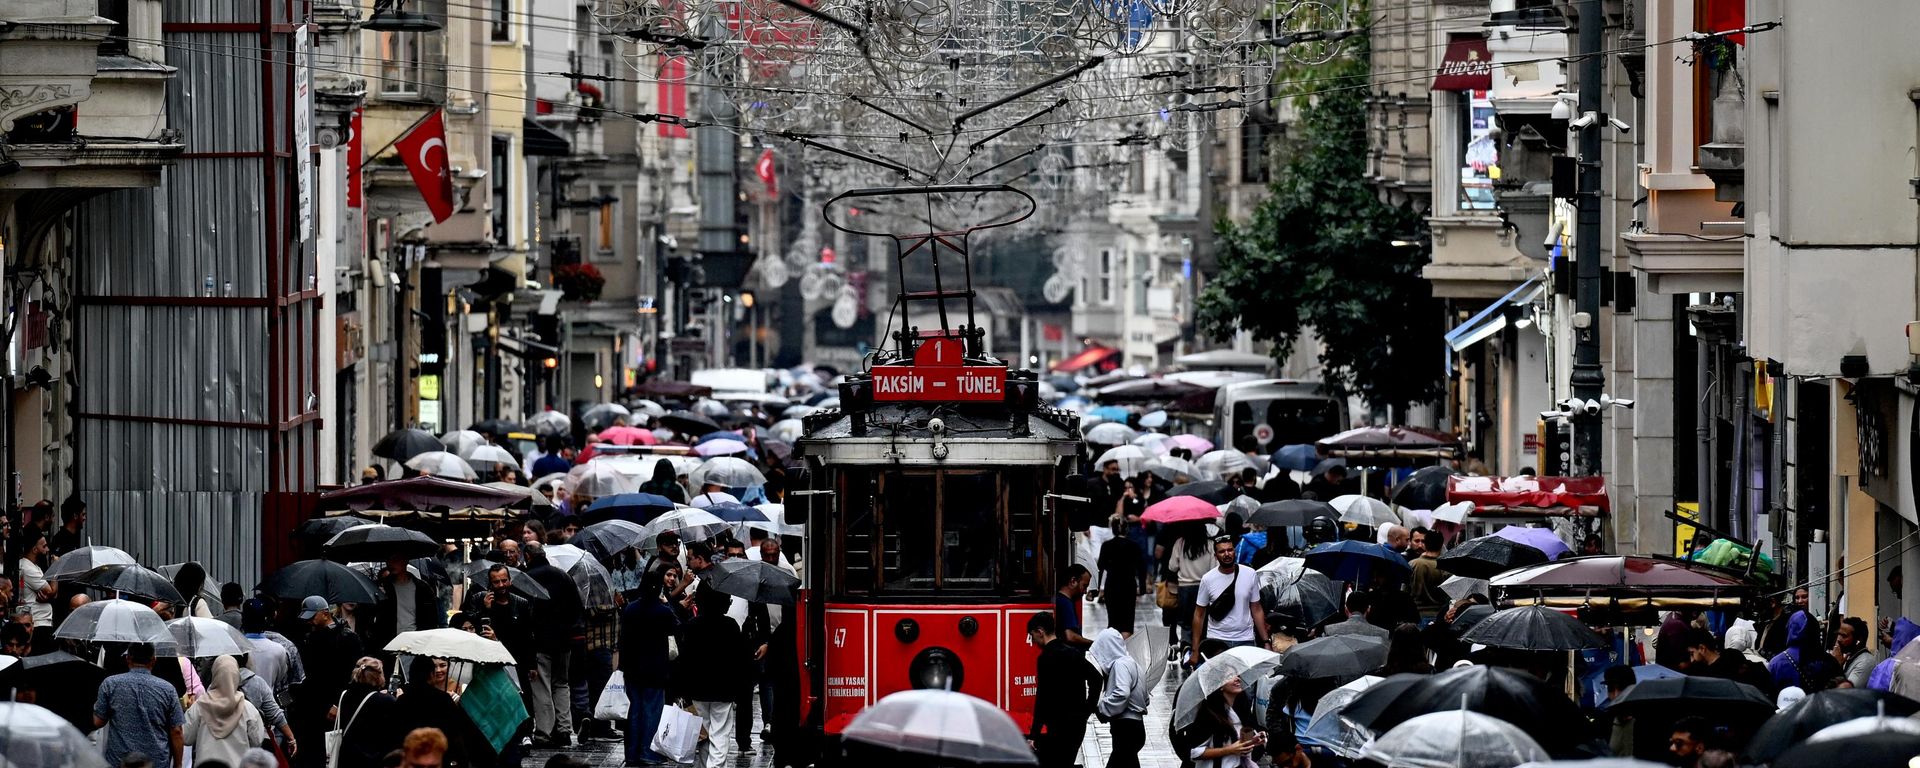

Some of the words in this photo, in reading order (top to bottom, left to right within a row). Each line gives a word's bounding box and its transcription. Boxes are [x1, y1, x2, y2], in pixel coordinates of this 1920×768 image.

[1443, 60, 1490, 76] TUDORS
[934, 340, 942, 363] 1
[874, 371, 924, 393] TAKSİM
[956, 372, 1001, 394] TÜNEL
[834, 628, 846, 648] 47
[845, 676, 865, 686] YASAK
